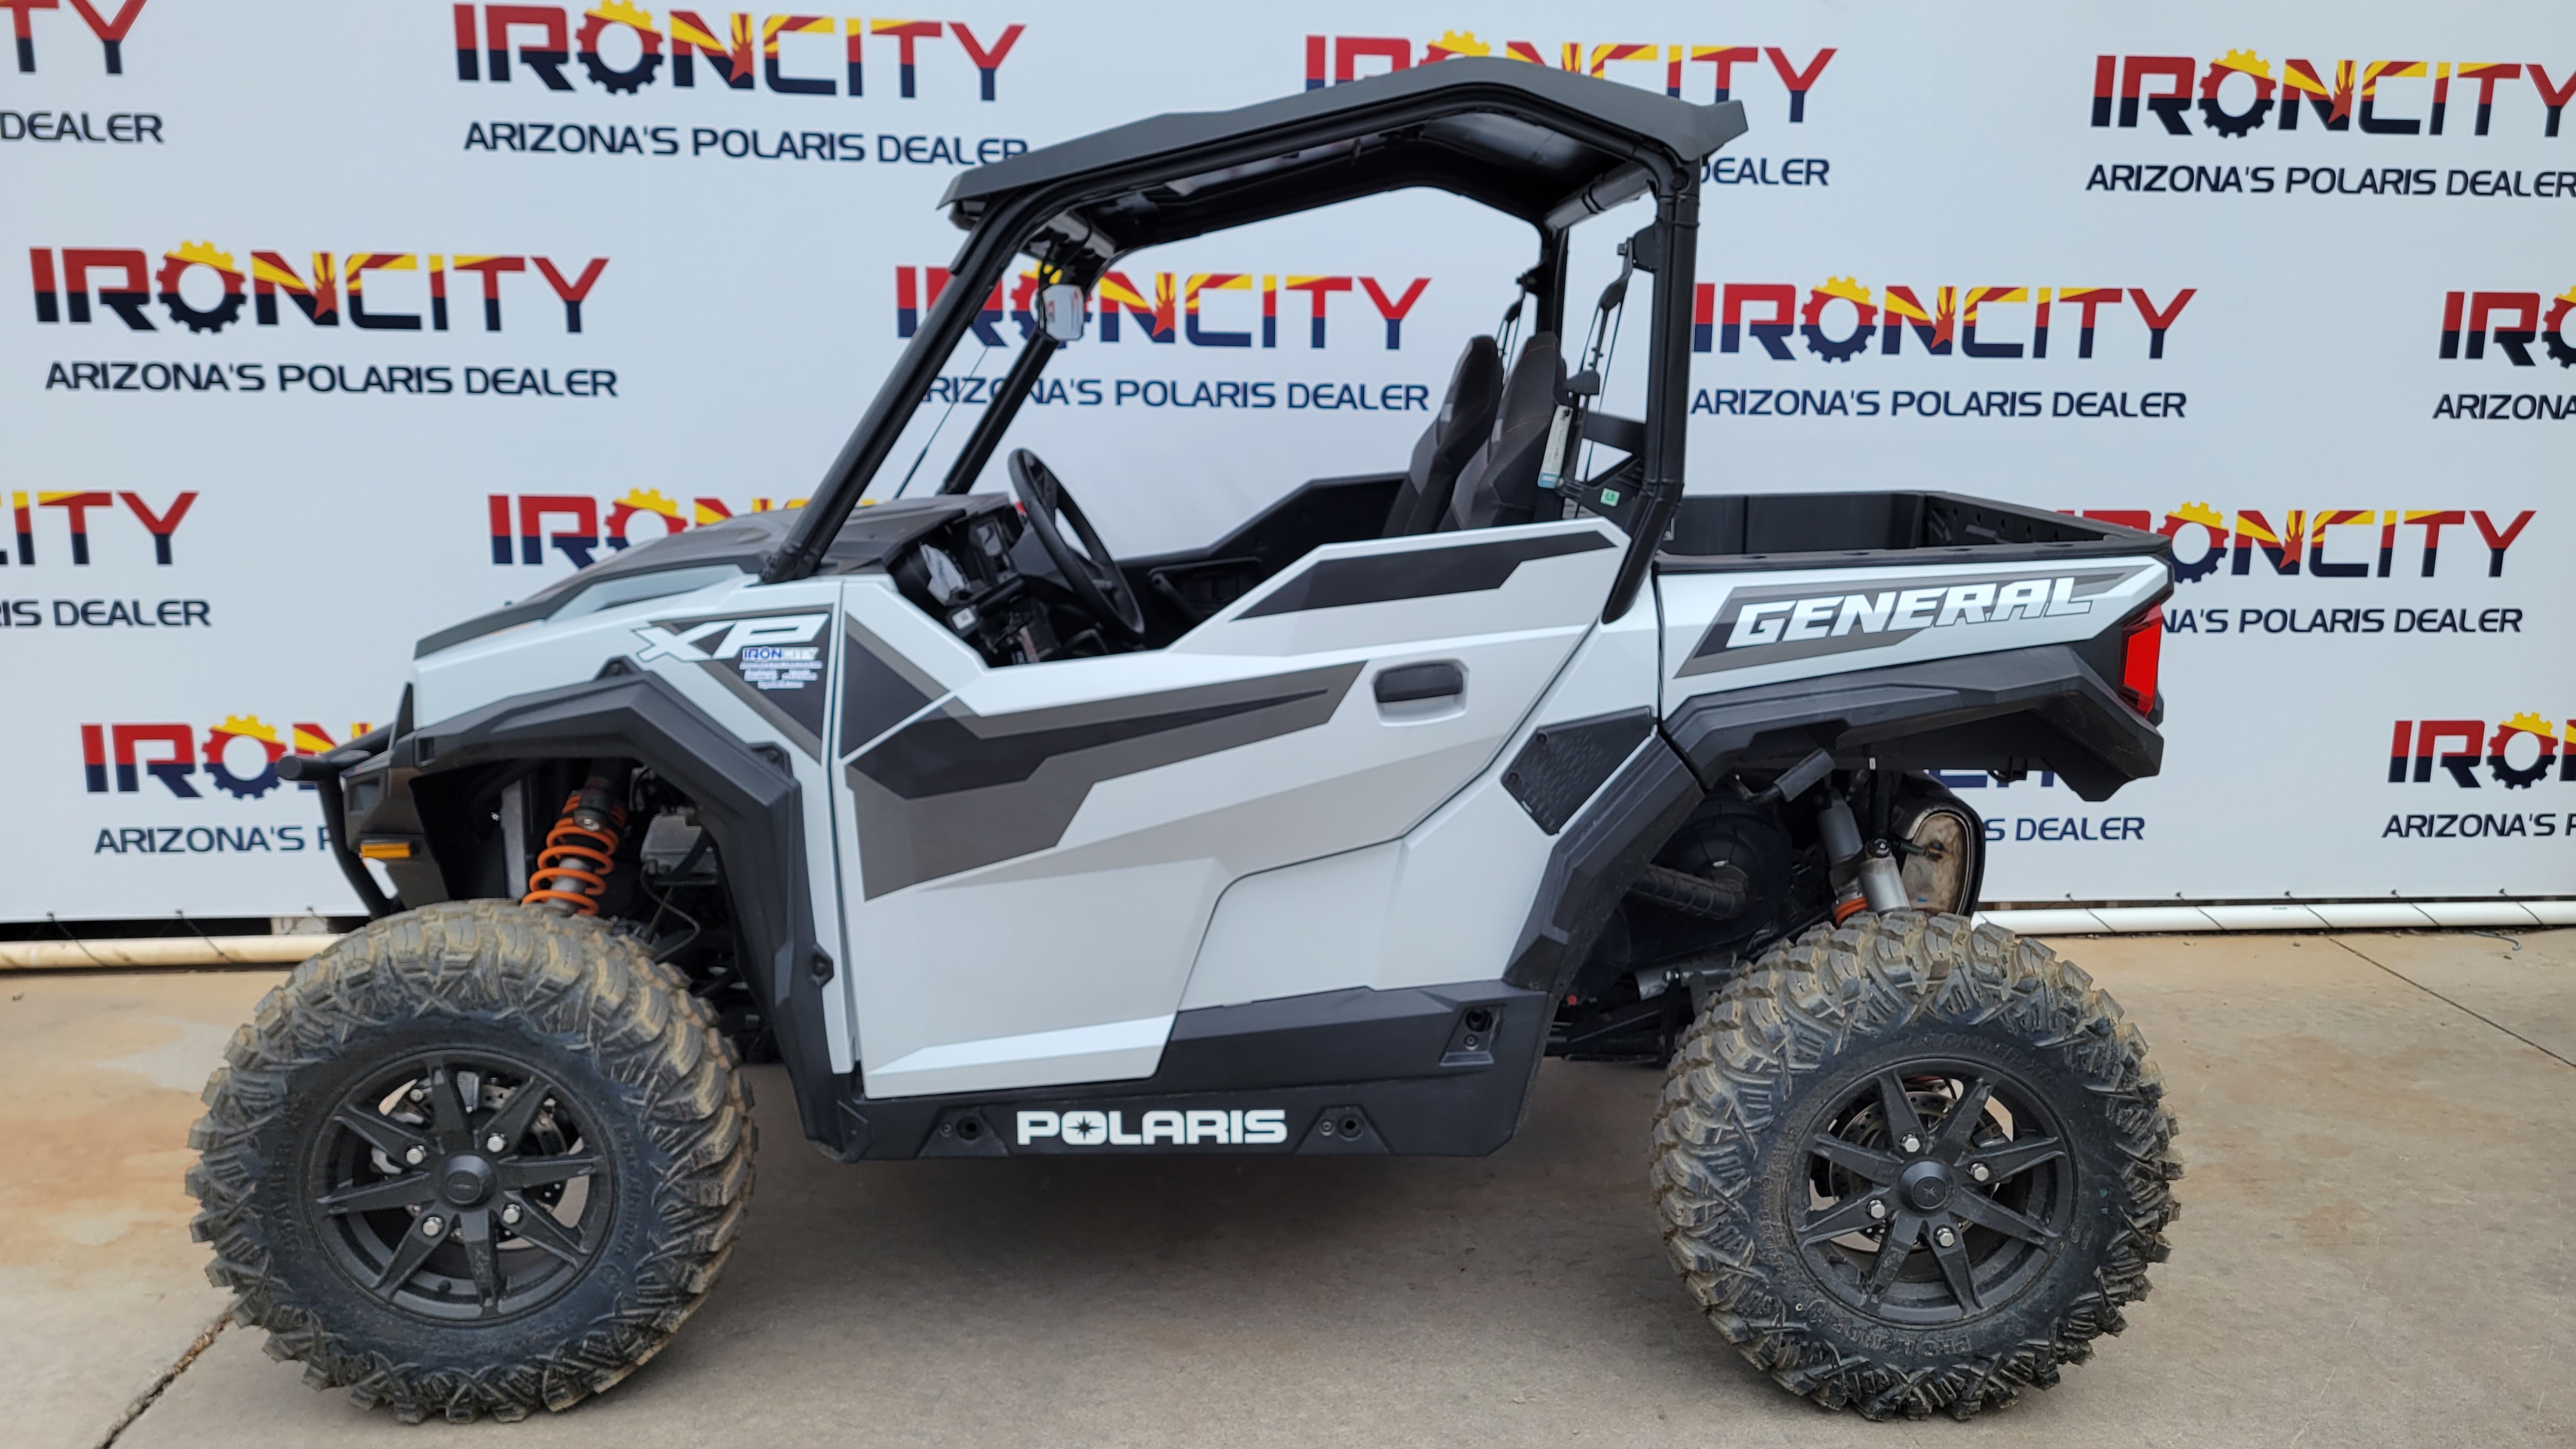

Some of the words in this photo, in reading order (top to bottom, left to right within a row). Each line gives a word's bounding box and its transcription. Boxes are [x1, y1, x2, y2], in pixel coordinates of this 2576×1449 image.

[454, 0, 1026, 102] IRONCITY
[0, 111, 165, 144] DEALER
[464, 122, 680, 157] ARIZONA'S
[693, 128, 866, 162] POLARIS
[2086, 165, 2275, 194] ARIZONA'S
[2286, 167, 2437, 196] POLARIS
[2446, 170, 2576, 199] DEALER
[30, 241, 610, 335] IRONCITY
[1693, 276, 2198, 364] IRONCITY
[46, 362, 266, 392] ARIZONA'S
[278, 364, 454, 395] POLARIS
[465, 367, 618, 398] DEALER
[1116, 380, 1276, 409] POLARIS
[1288, 383, 1429, 411] DEALER
[1690, 388, 1880, 417] ARIZONA'S
[1892, 391, 2043, 418] POLARIS
[2053, 392, 2187, 418] DEALER
[54, 600, 212, 628] DEALER
[1724, 577, 2093, 648] GENERAL
[2239, 609, 2385, 634] POLARIS
[2395, 609, 2523, 633] DEALER
[631, 613, 830, 663] XP
[95, 827, 306, 854] ARIZONA'S
[2016, 818, 2145, 841] DEALER
[2382, 814, 2556, 838] ARIZONA'S
[1016, 1109, 1288, 1146] POLARIS
